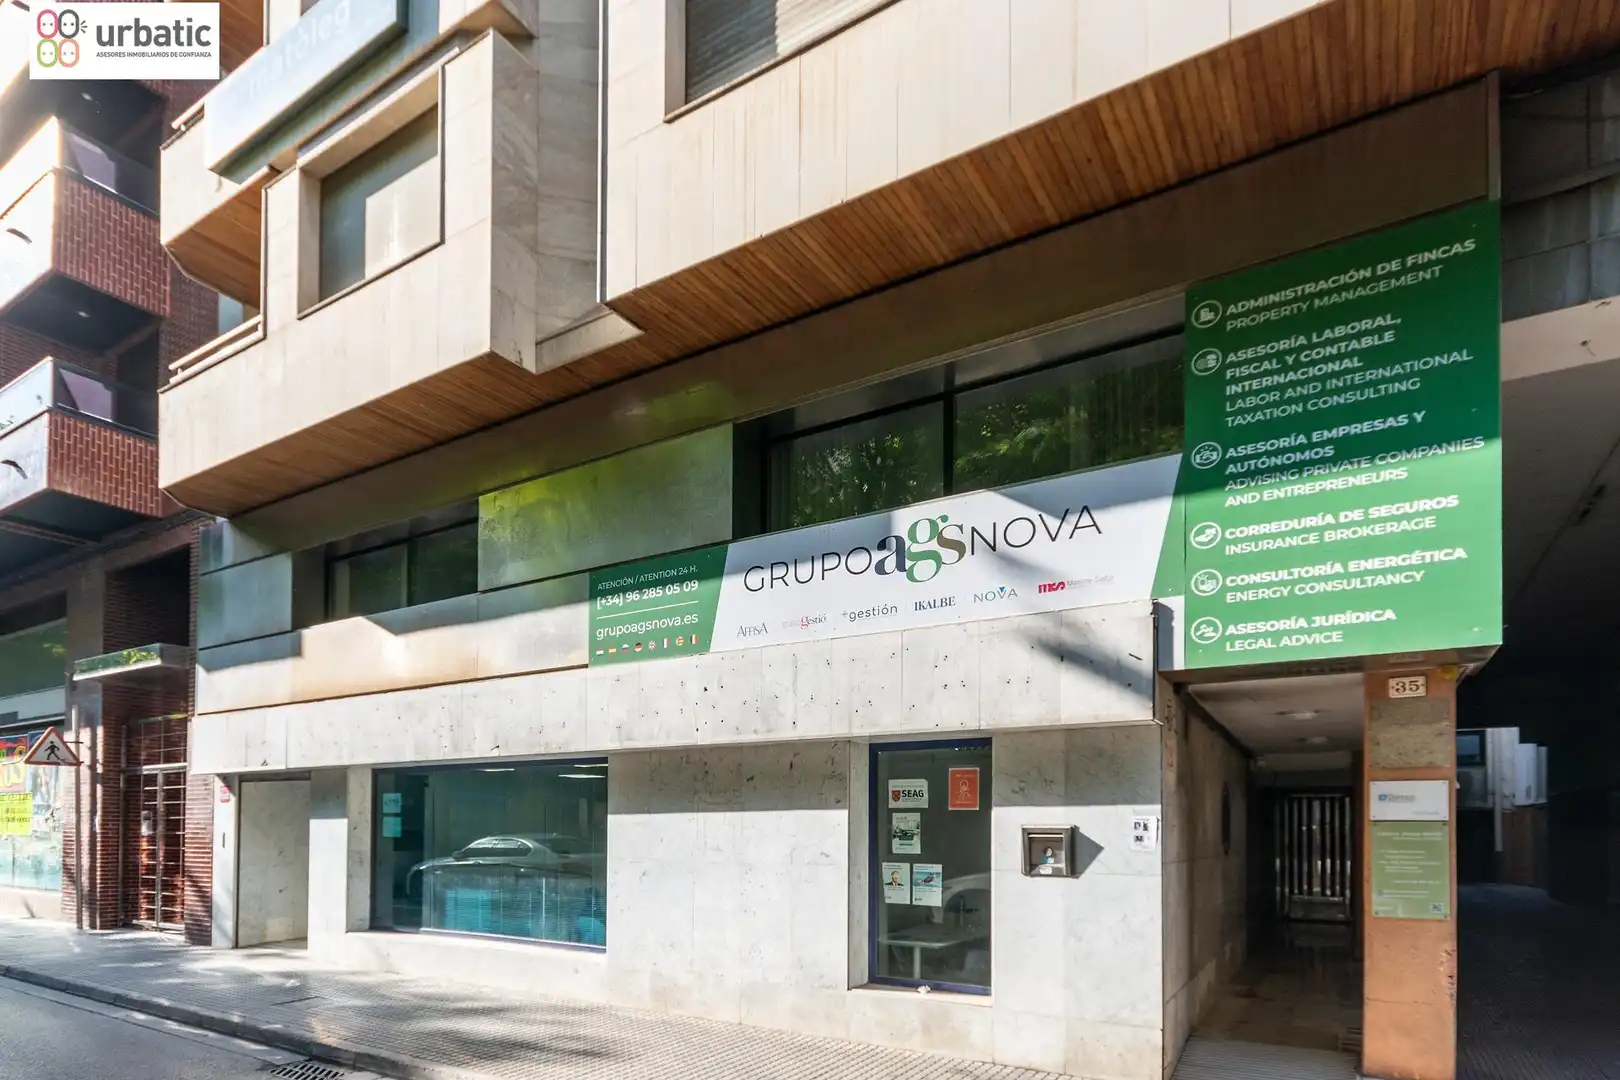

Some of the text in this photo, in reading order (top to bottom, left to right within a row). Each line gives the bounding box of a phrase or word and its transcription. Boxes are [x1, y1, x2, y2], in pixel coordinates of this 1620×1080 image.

[1226, 239, 1476, 315] ADMINISTRACIÓN DE FINCAS
[1227, 265, 1444, 331] PROPERTY MANAGEMENT
[1226, 313, 1402, 363] ASESORÍA LABORAL,
[1226, 331, 1396, 379] FISCAL Y CONTABLE
[1226, 356, 1363, 395] INTERNACIONAL
[1226, 349, 1473, 411] LABOR AND INTERNATIONAL
[1226, 378, 1421, 426] TAXATION CONSULTING
[1226, 411, 1426, 458] ASESORÍA EMPRESAS Y
[1225, 446, 1335, 475] AUTÓNOMOS
[1225, 436, 1485, 491] ADVISING PRIVATE COMPANIES
[1225, 468, 1408, 507] AND ENTREPRENEURS
[1225, 495, 1459, 540] CORREDURÍA DE SEGUROS
[1225, 516, 1436, 555] INSURANCE BROKERAGE
[597, 576, 634, 591] ATENCIÓN
[640, 569, 677, 582] ATENTION
[678, 566, 689, 575] 24
[690, 565, 698, 573] H.
[1226, 547, 1467, 586] CONSULTORÍA ENERGÉTICA
[626, 587, 640, 602] 96
[642, 585, 663, 600] 285
[666, 582, 681, 596] 05
[683, 579, 699, 593] 09
[914, 596, 955, 611] IKALBE
[973, 587, 1018, 603] NOVA
[1226, 570, 1425, 603] ENERGY CONSULTANCY
[596, 612, 699, 640] grupoagsnova.es
[1226, 609, 1397, 635] ASESORÍA JURÍDICA
[1226, 632, 1343, 651] LEGAL ADVICE
[1396, 680, 1420, 693] 35
